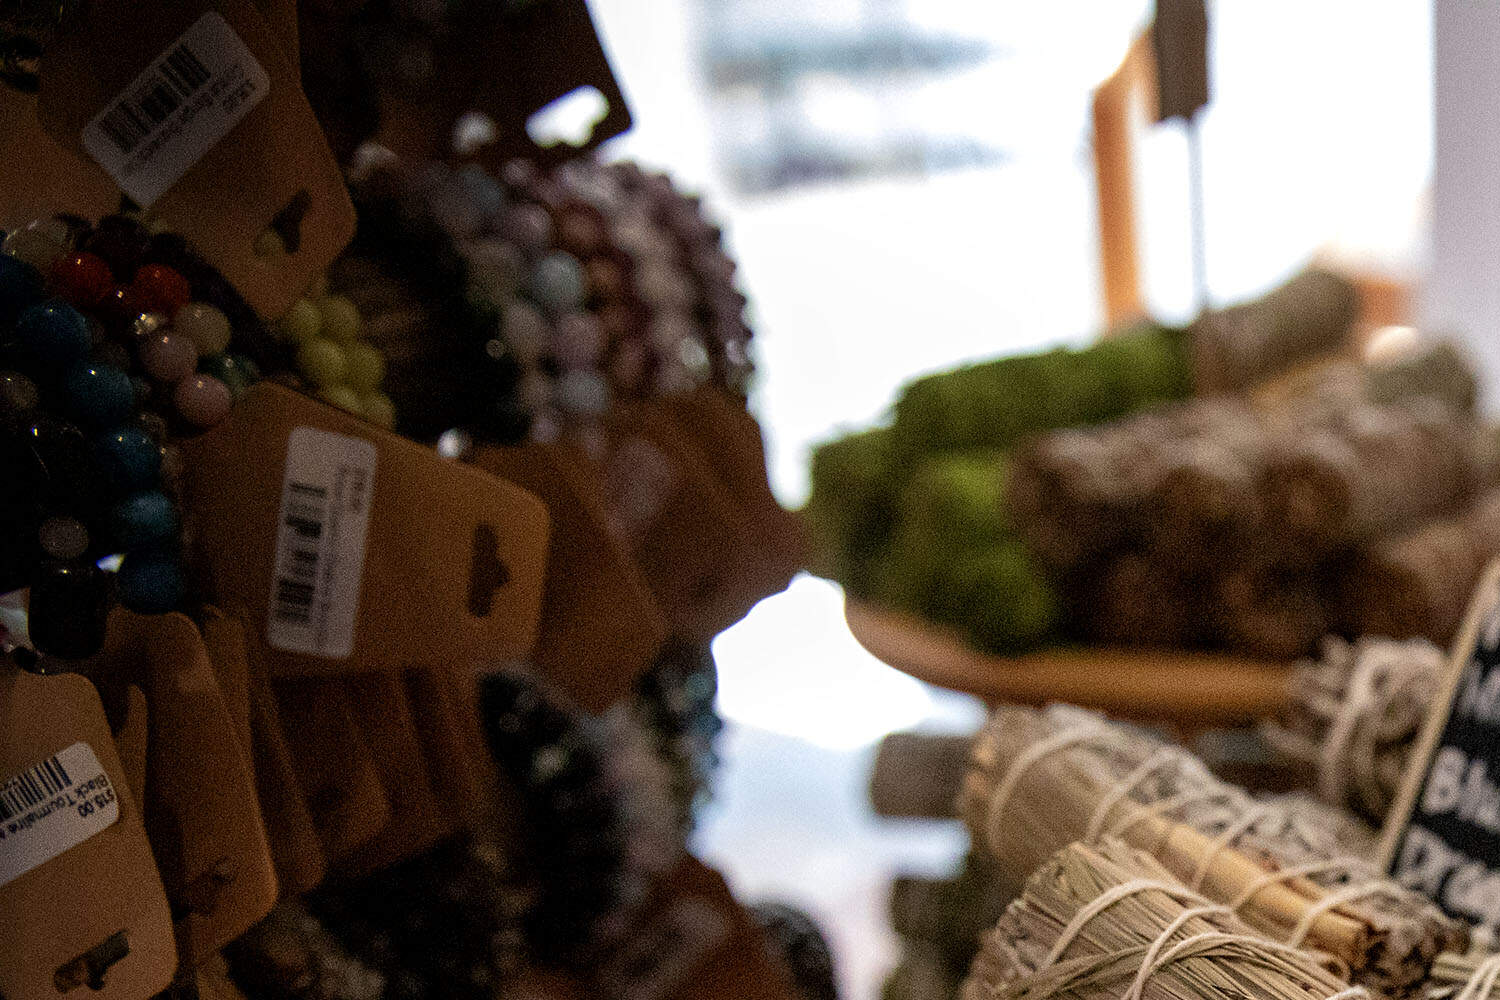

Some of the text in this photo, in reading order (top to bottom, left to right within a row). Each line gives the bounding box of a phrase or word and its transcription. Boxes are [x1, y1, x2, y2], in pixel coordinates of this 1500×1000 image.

[75, 773, 109, 800] Black
[7, 793, 76, 835] Tourmaline
[78, 788, 117, 818] $15.00
